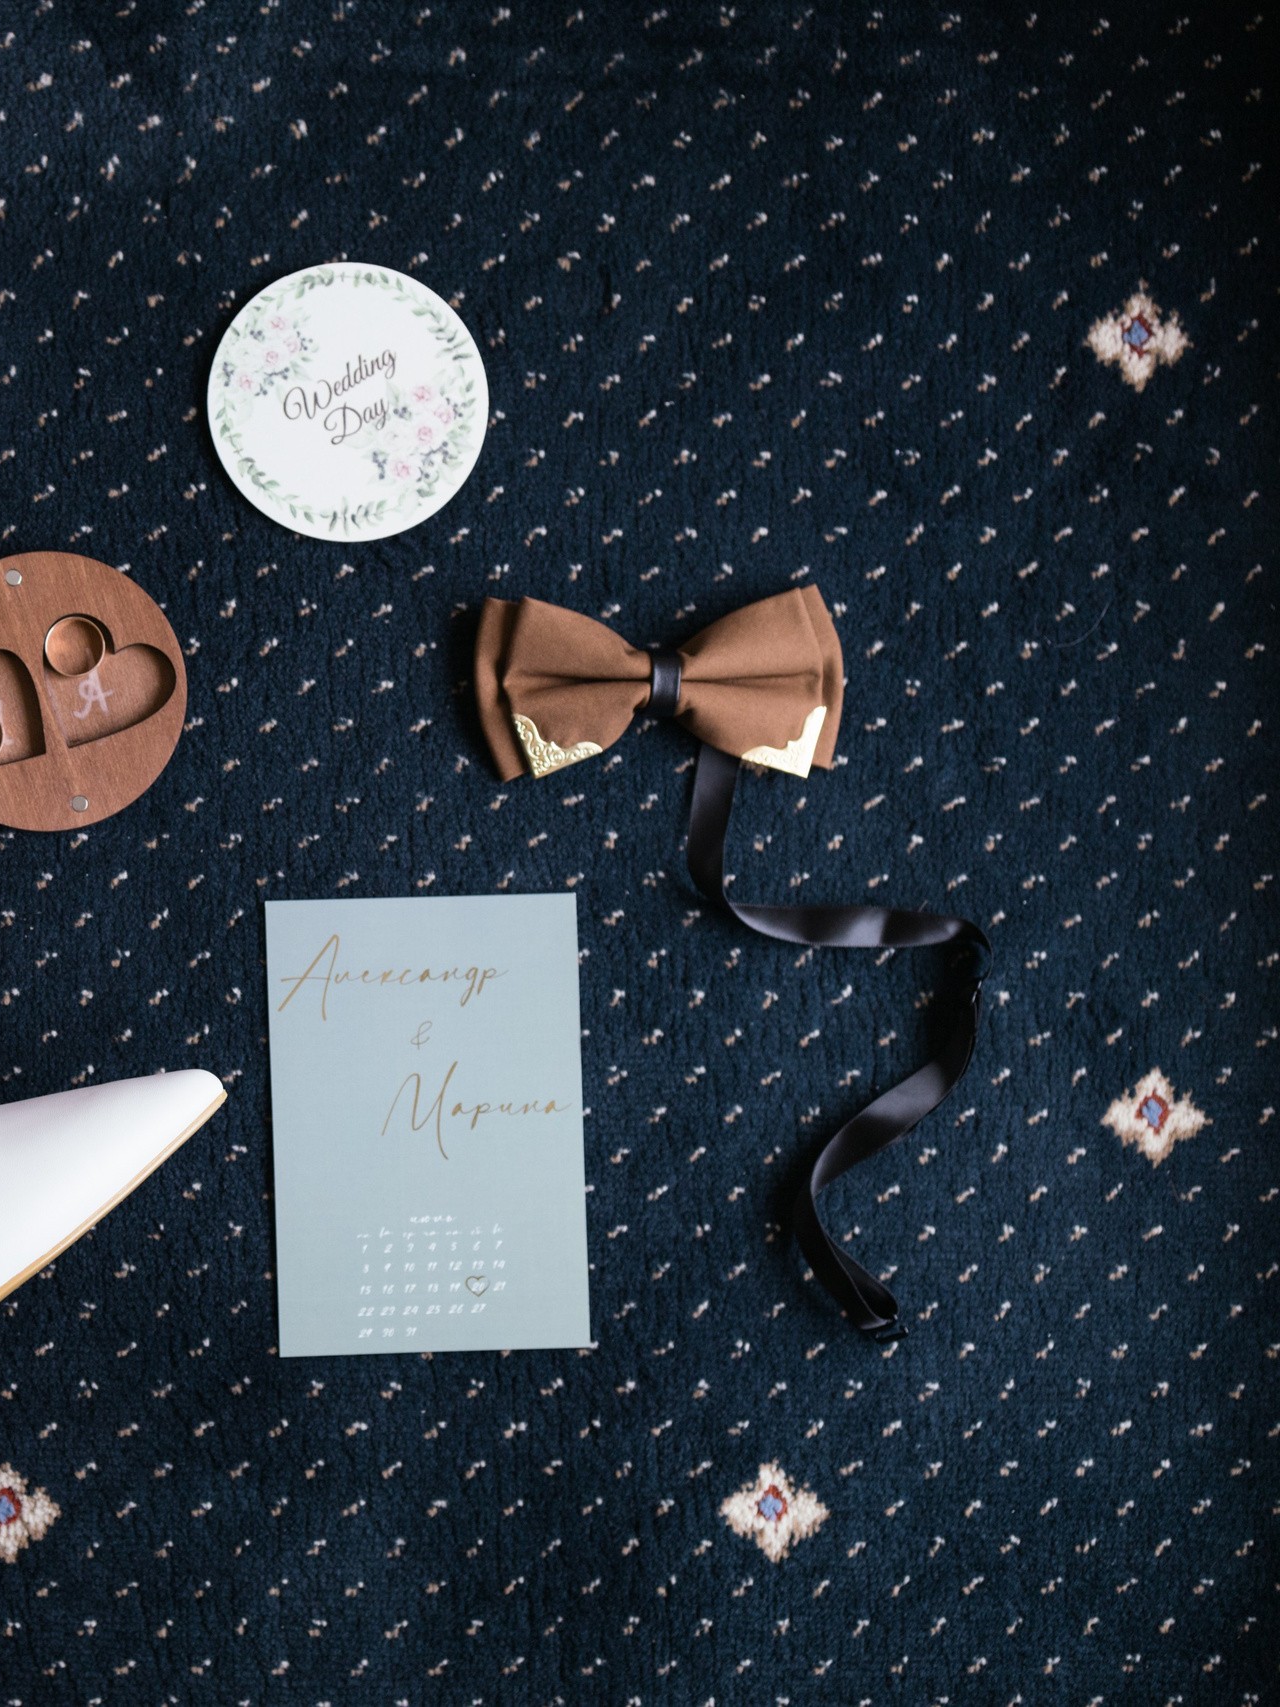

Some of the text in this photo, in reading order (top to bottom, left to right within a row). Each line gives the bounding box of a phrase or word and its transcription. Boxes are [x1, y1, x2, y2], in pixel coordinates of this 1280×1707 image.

[283, 349, 398, 421] Wedding
[323, 397, 389, 446] Day
[277, 934, 509, 1021] Александр
[410, 1020, 433, 1050] &
[382, 1060, 572, 1160] Марина
[361, 1243, 369, 1254] 1
[383, 1242, 394, 1254] 2
[427, 1241, 437, 1252] 4
[450, 1241, 459, 1252] 5
[472, 1240, 481, 1252] 6
[494, 1239, 503, 1250] 7
[383, 1262, 392, 1273] 9
[403, 1262, 416, 1273] 10
[426, 1261, 438, 1272] 11
[448, 1260, 463, 1272] 12
[471, 1259, 485, 1271] 13
[492, 1259, 506, 1270] 14
[359, 1280, 507, 1296] 15 16 17 18 19 20 21
[356, 1302, 487, 1318] 22 23 24 25 26 27
[357, 1326, 418, 1339] 29 30 31
